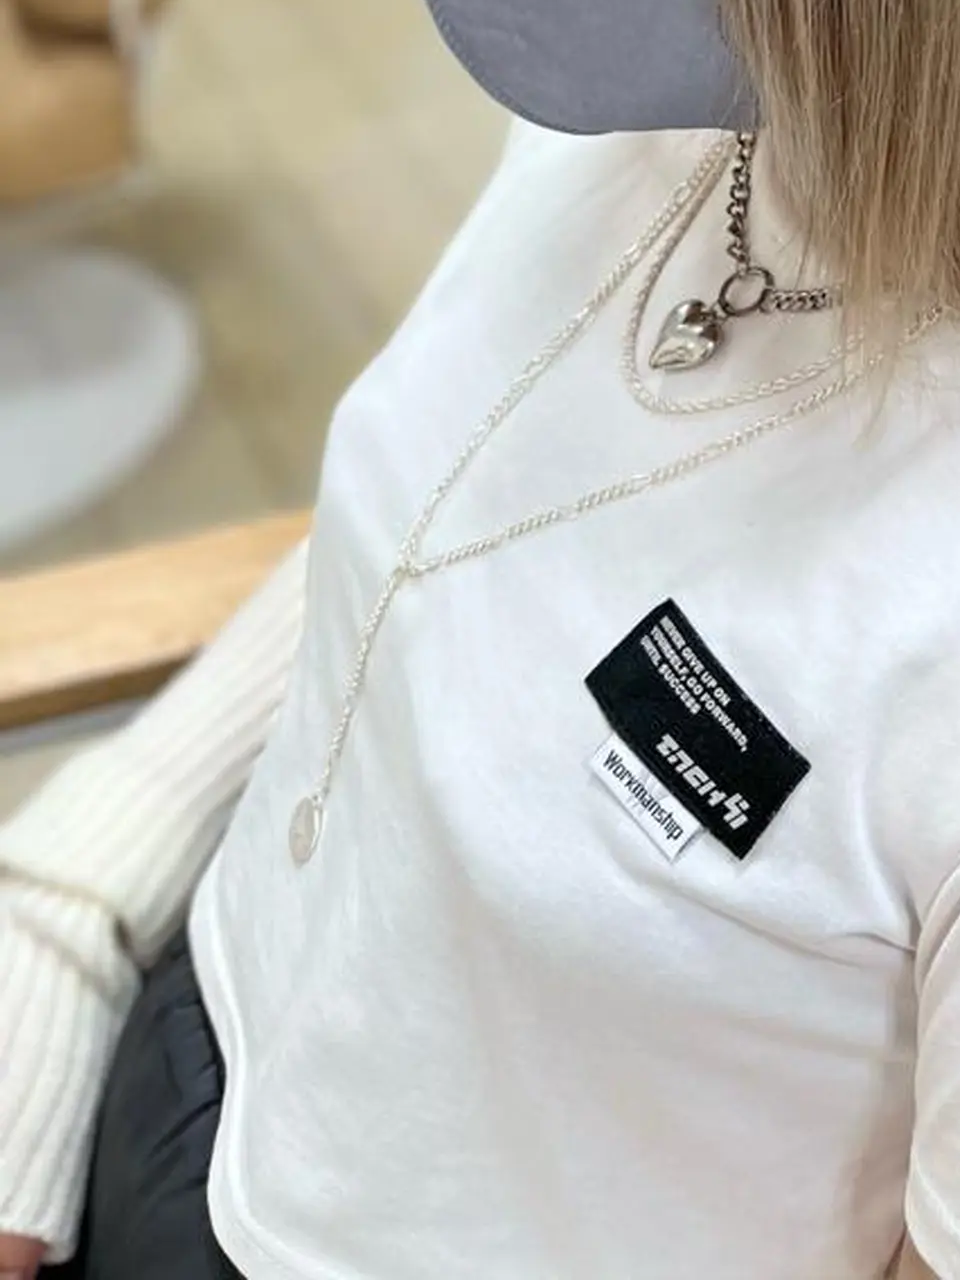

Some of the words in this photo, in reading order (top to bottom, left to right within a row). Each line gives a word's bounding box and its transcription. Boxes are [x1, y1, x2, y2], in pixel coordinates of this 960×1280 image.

[658, 663, 701, 714] SUCCESS
[681, 646, 705, 675] GIVE
[701, 671, 718, 688] UP
[713, 687, 731, 706] ON
[686, 676, 704, 696] GO
[700, 692, 748, 753] FORWARD,
[603, 749, 684, 841] Workmanship
